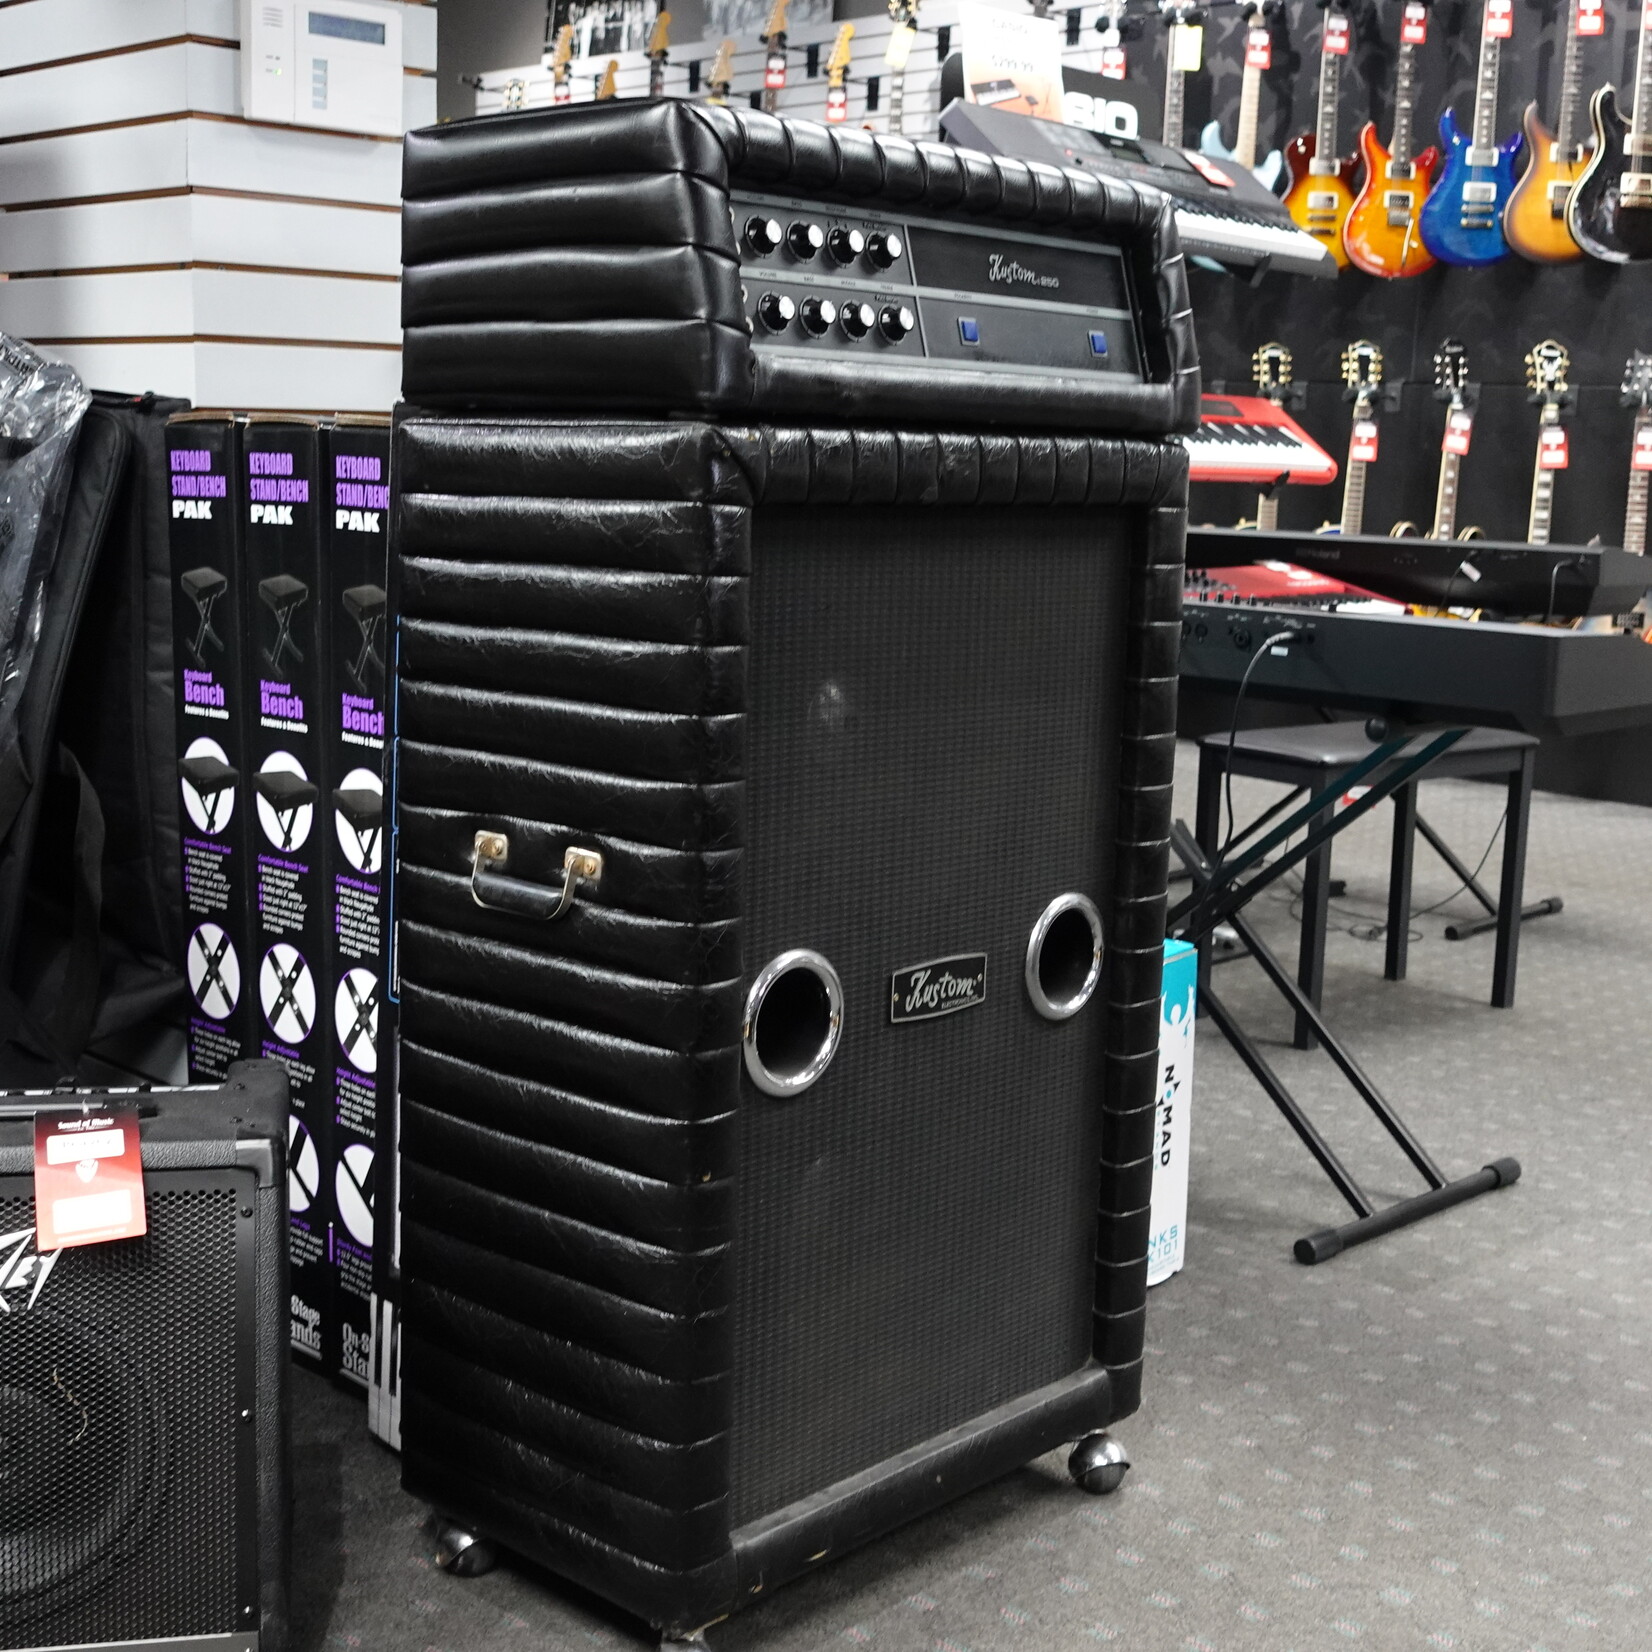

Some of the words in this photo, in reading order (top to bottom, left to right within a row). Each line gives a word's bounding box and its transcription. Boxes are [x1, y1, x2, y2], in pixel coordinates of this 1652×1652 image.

[989, 253, 1037, 286] Kustom
[170, 450, 211, 472] KEYBOARD
[249, 452, 293, 475] KEYBOARD
[335, 455, 381, 480] KEYBOARD
[171, 475, 226, 497] STAND/BENCH
[250, 478, 308, 502] STAND/BENCH
[335, 482, 389, 509] STAND/BENC
[172, 500, 212, 519] PAK
[250, 504, 293, 525] PAK
[335, 509, 380, 532] PAK
[184, 680, 225, 707] Bench
[261, 691, 304, 720] Bench
[905, 969, 975, 1012] Kustom
